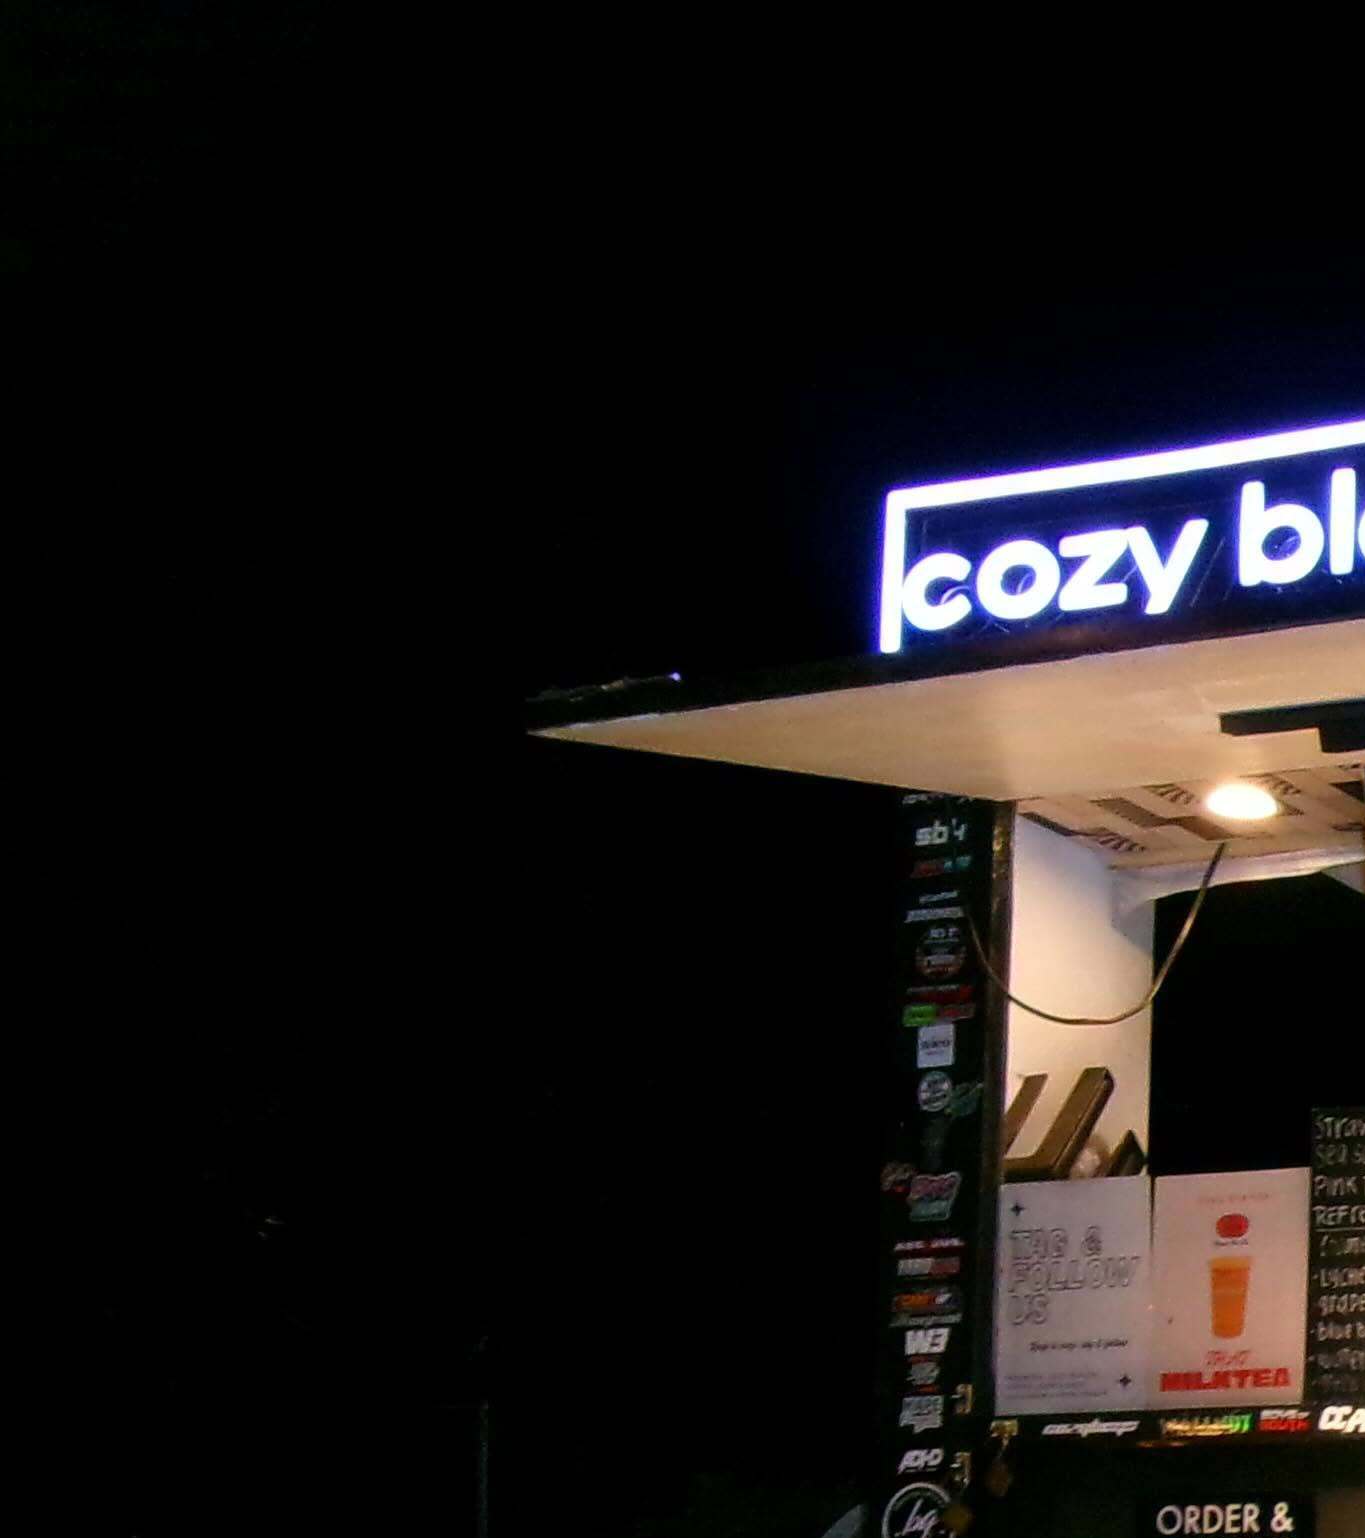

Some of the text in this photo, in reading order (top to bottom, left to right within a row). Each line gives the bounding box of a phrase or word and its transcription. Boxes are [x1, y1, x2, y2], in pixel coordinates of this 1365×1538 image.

[904, 519, 1208, 631] cozy
[1160, 1367, 1291, 1392] MILKTEA
[1155, 1501, 1295, 1537] ORDER &
